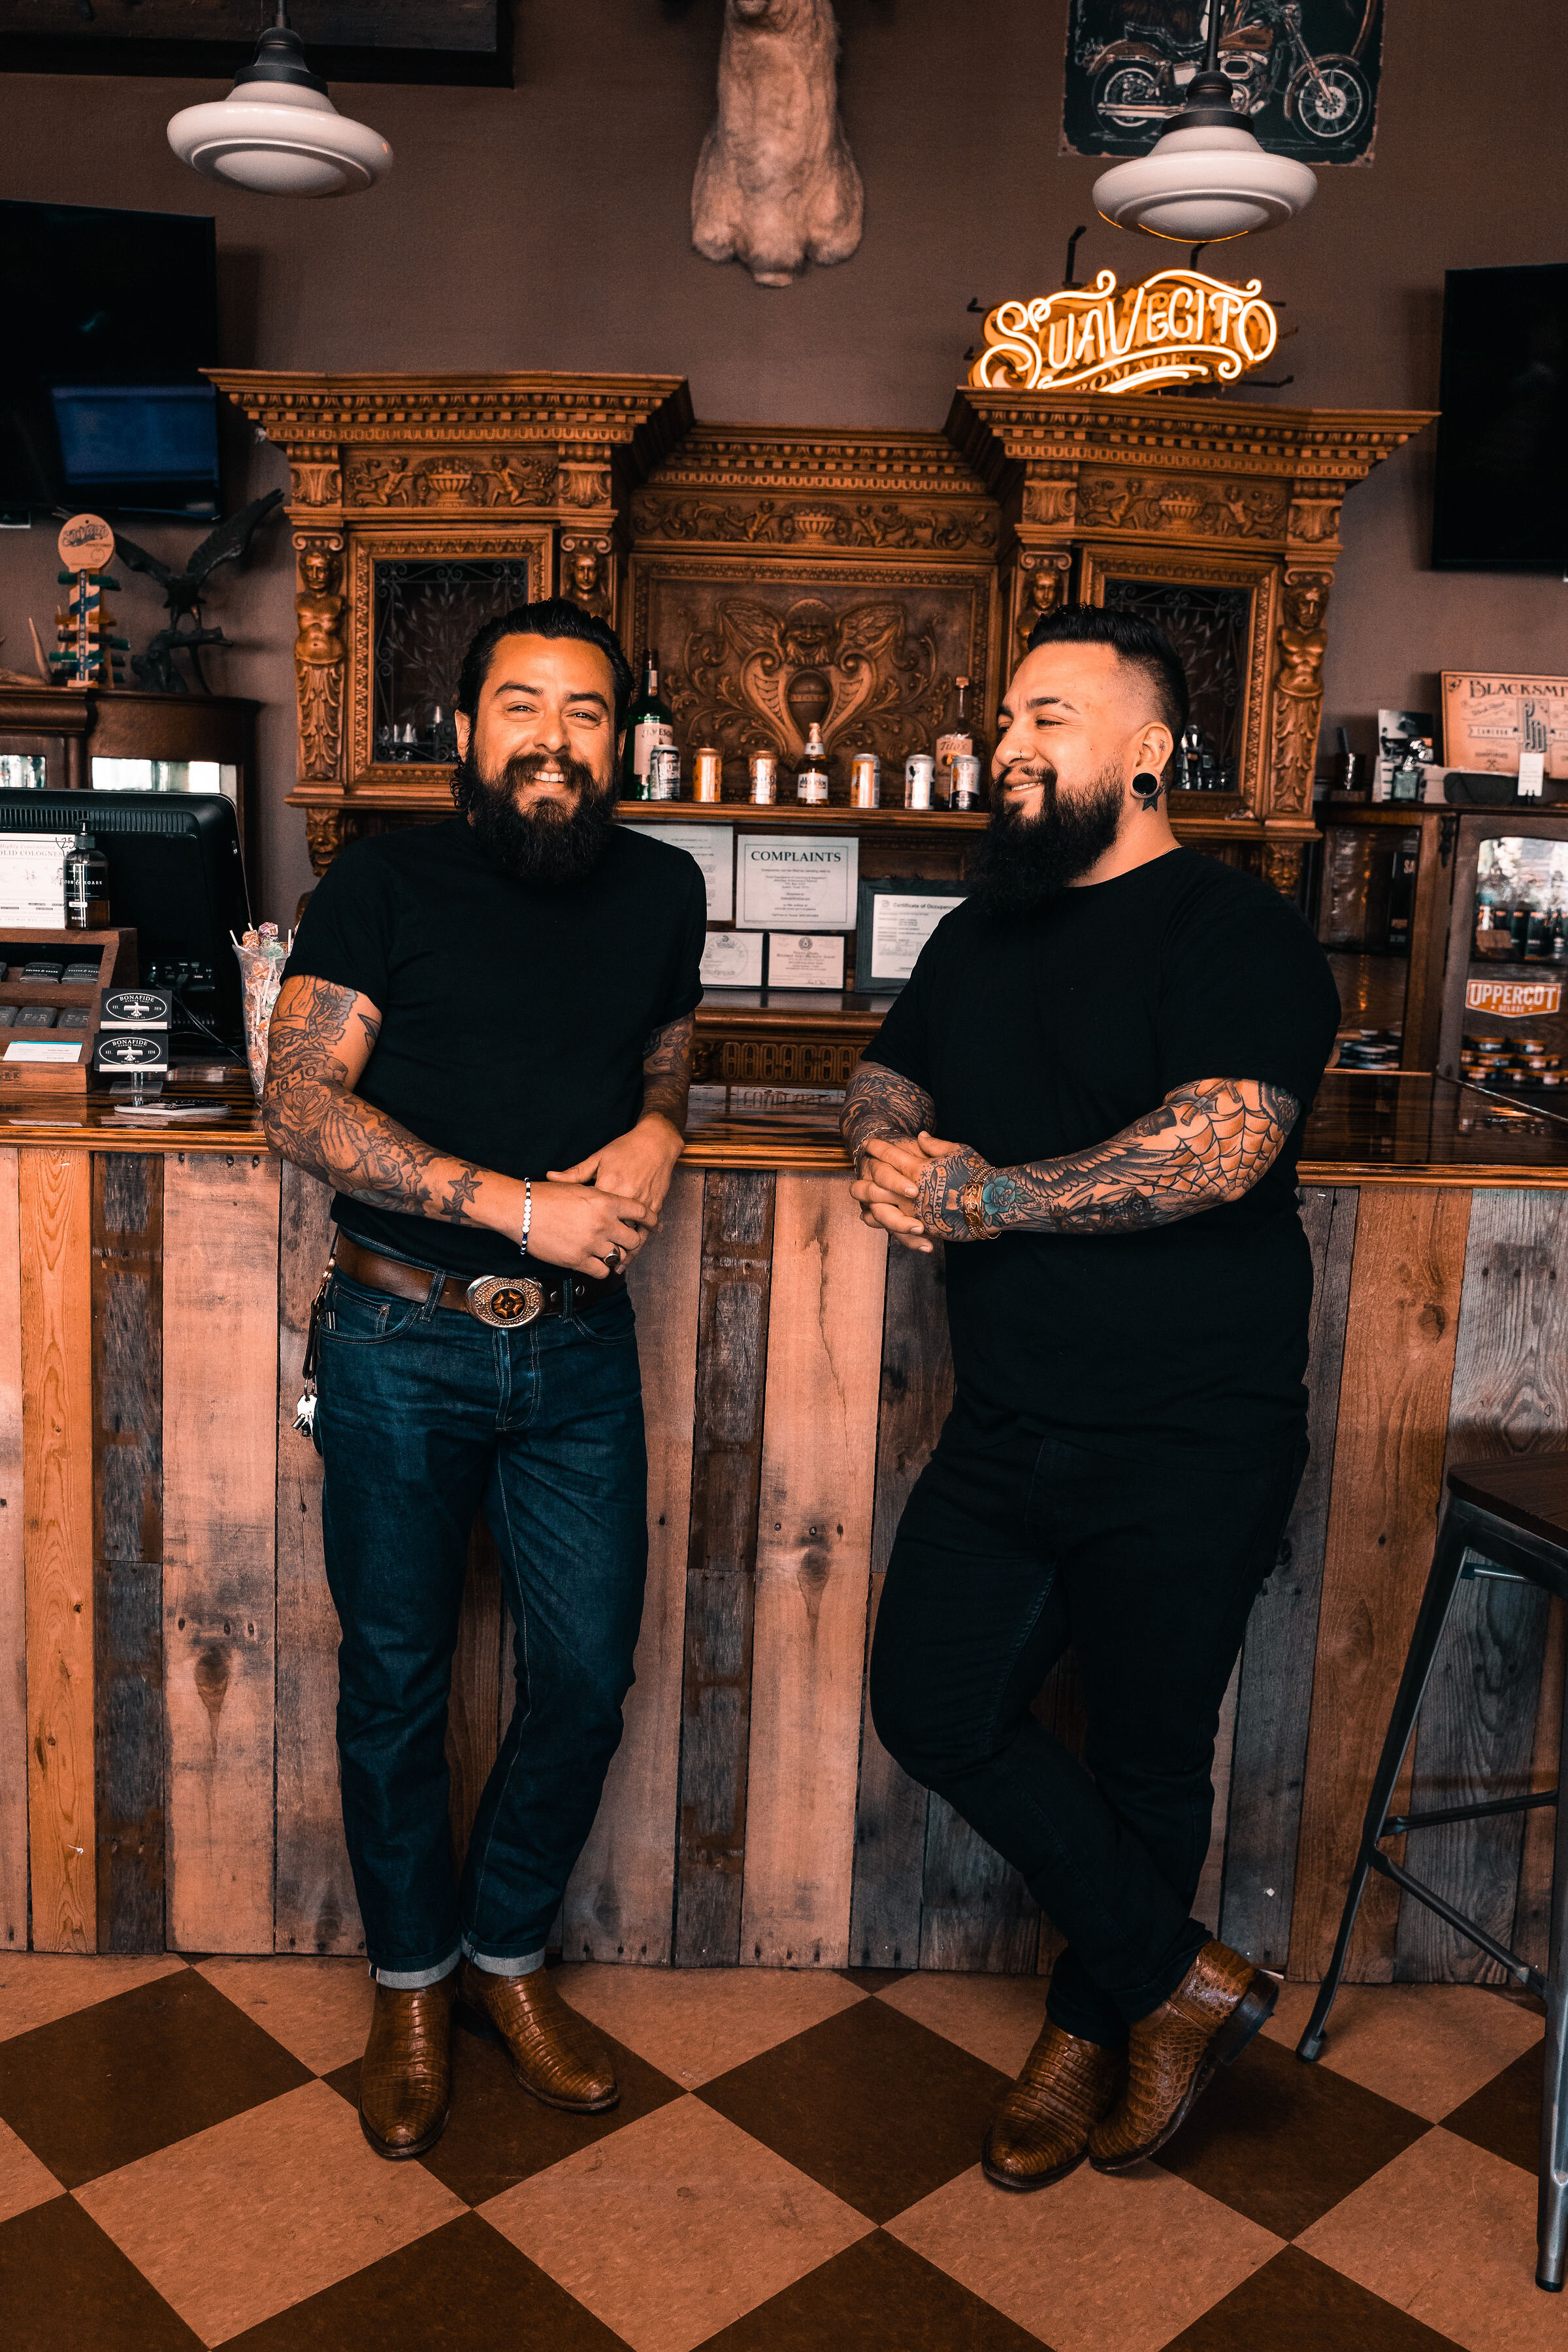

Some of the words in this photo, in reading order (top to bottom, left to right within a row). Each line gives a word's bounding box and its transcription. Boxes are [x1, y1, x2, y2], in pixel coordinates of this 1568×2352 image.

[972, 270, 1278, 389] SUAVECITO
[751, 851, 841, 862] COMPLAINTS
[1470, 983, 1558, 1009] UPPERCUT
[934, 1176, 946, 1219] HILARIO
